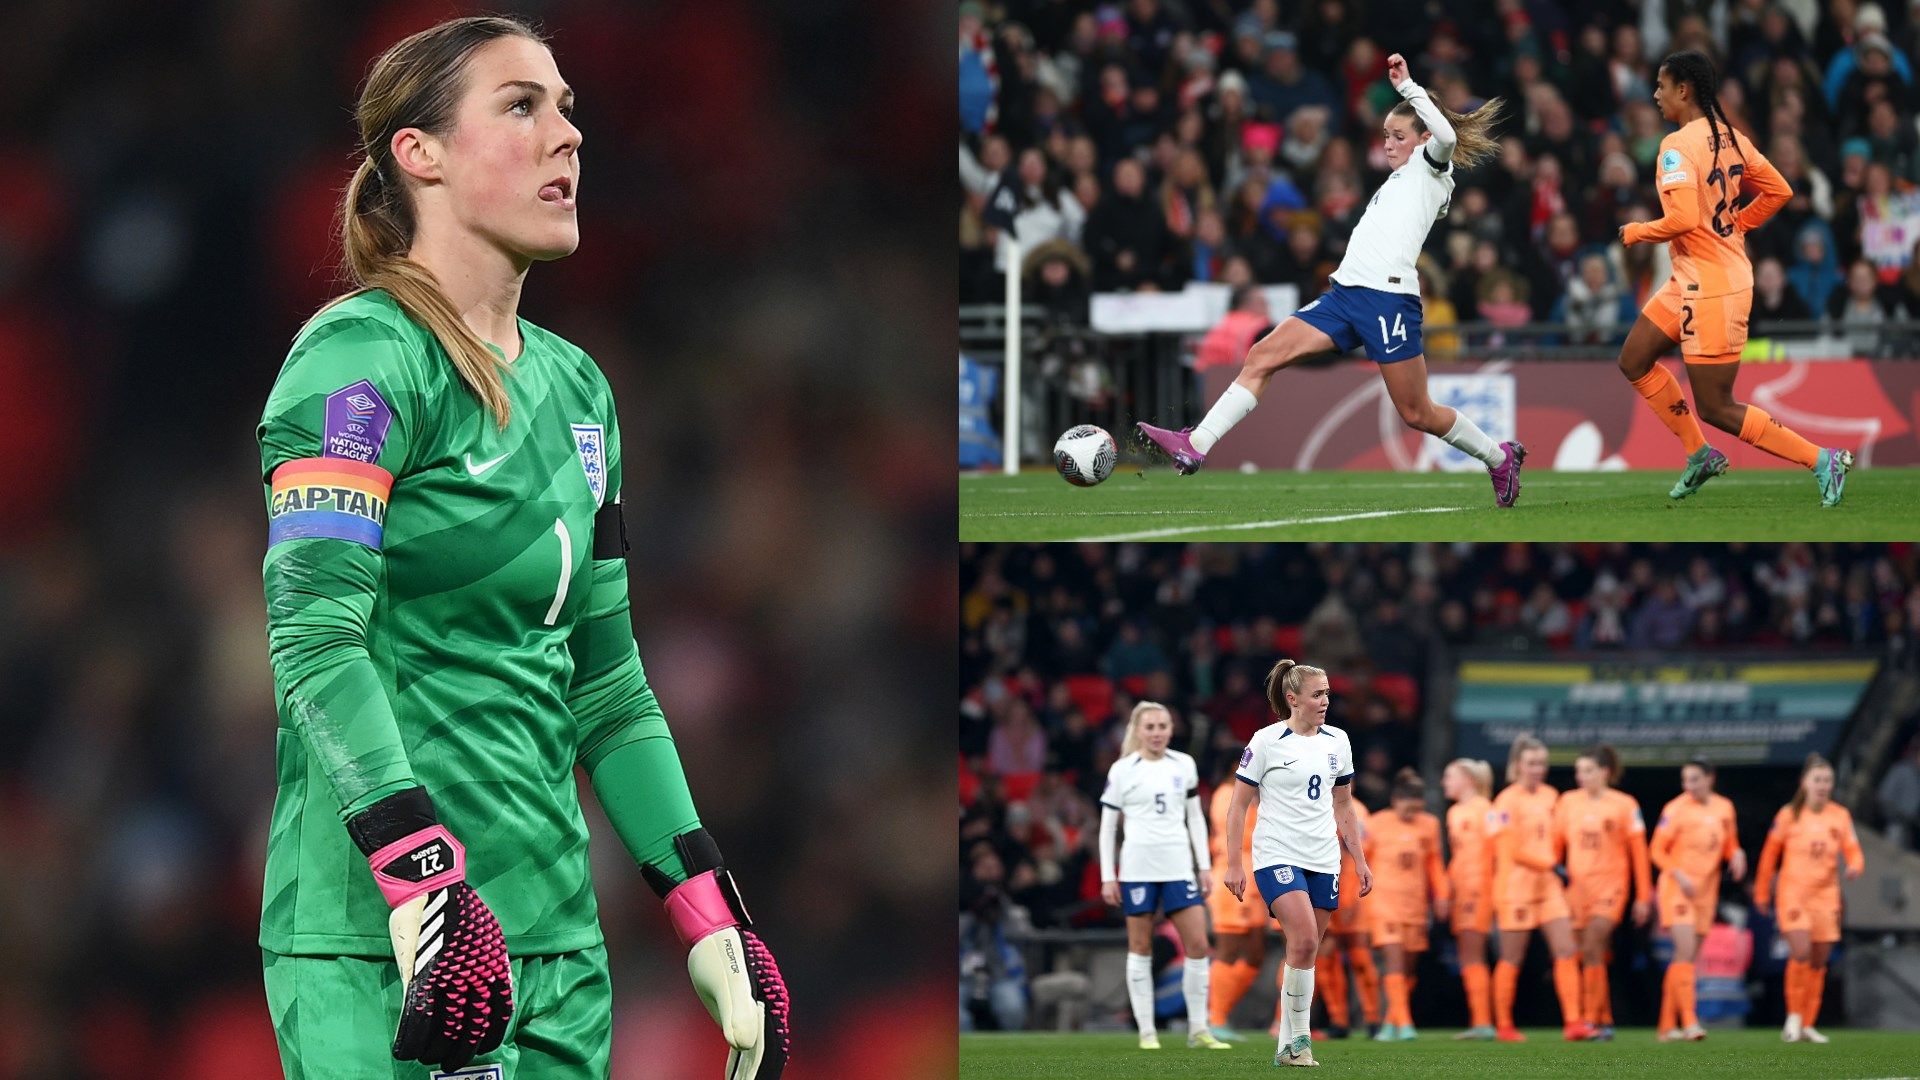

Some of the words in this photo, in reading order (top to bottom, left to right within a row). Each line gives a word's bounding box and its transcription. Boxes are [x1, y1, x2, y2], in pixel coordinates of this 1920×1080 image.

[1378, 312, 1408, 345] 14
[330, 436, 373, 455] NATIONS
[338, 430, 370, 445] women's
[330, 444, 369, 463] LEAGUE
[543, 517, 572, 626] 1
[1307, 774, 1322, 800] 8
[1154, 793, 1167, 815] 5
[421, 853, 445, 877] 27
[724, 938, 740, 974] PREDATOR
